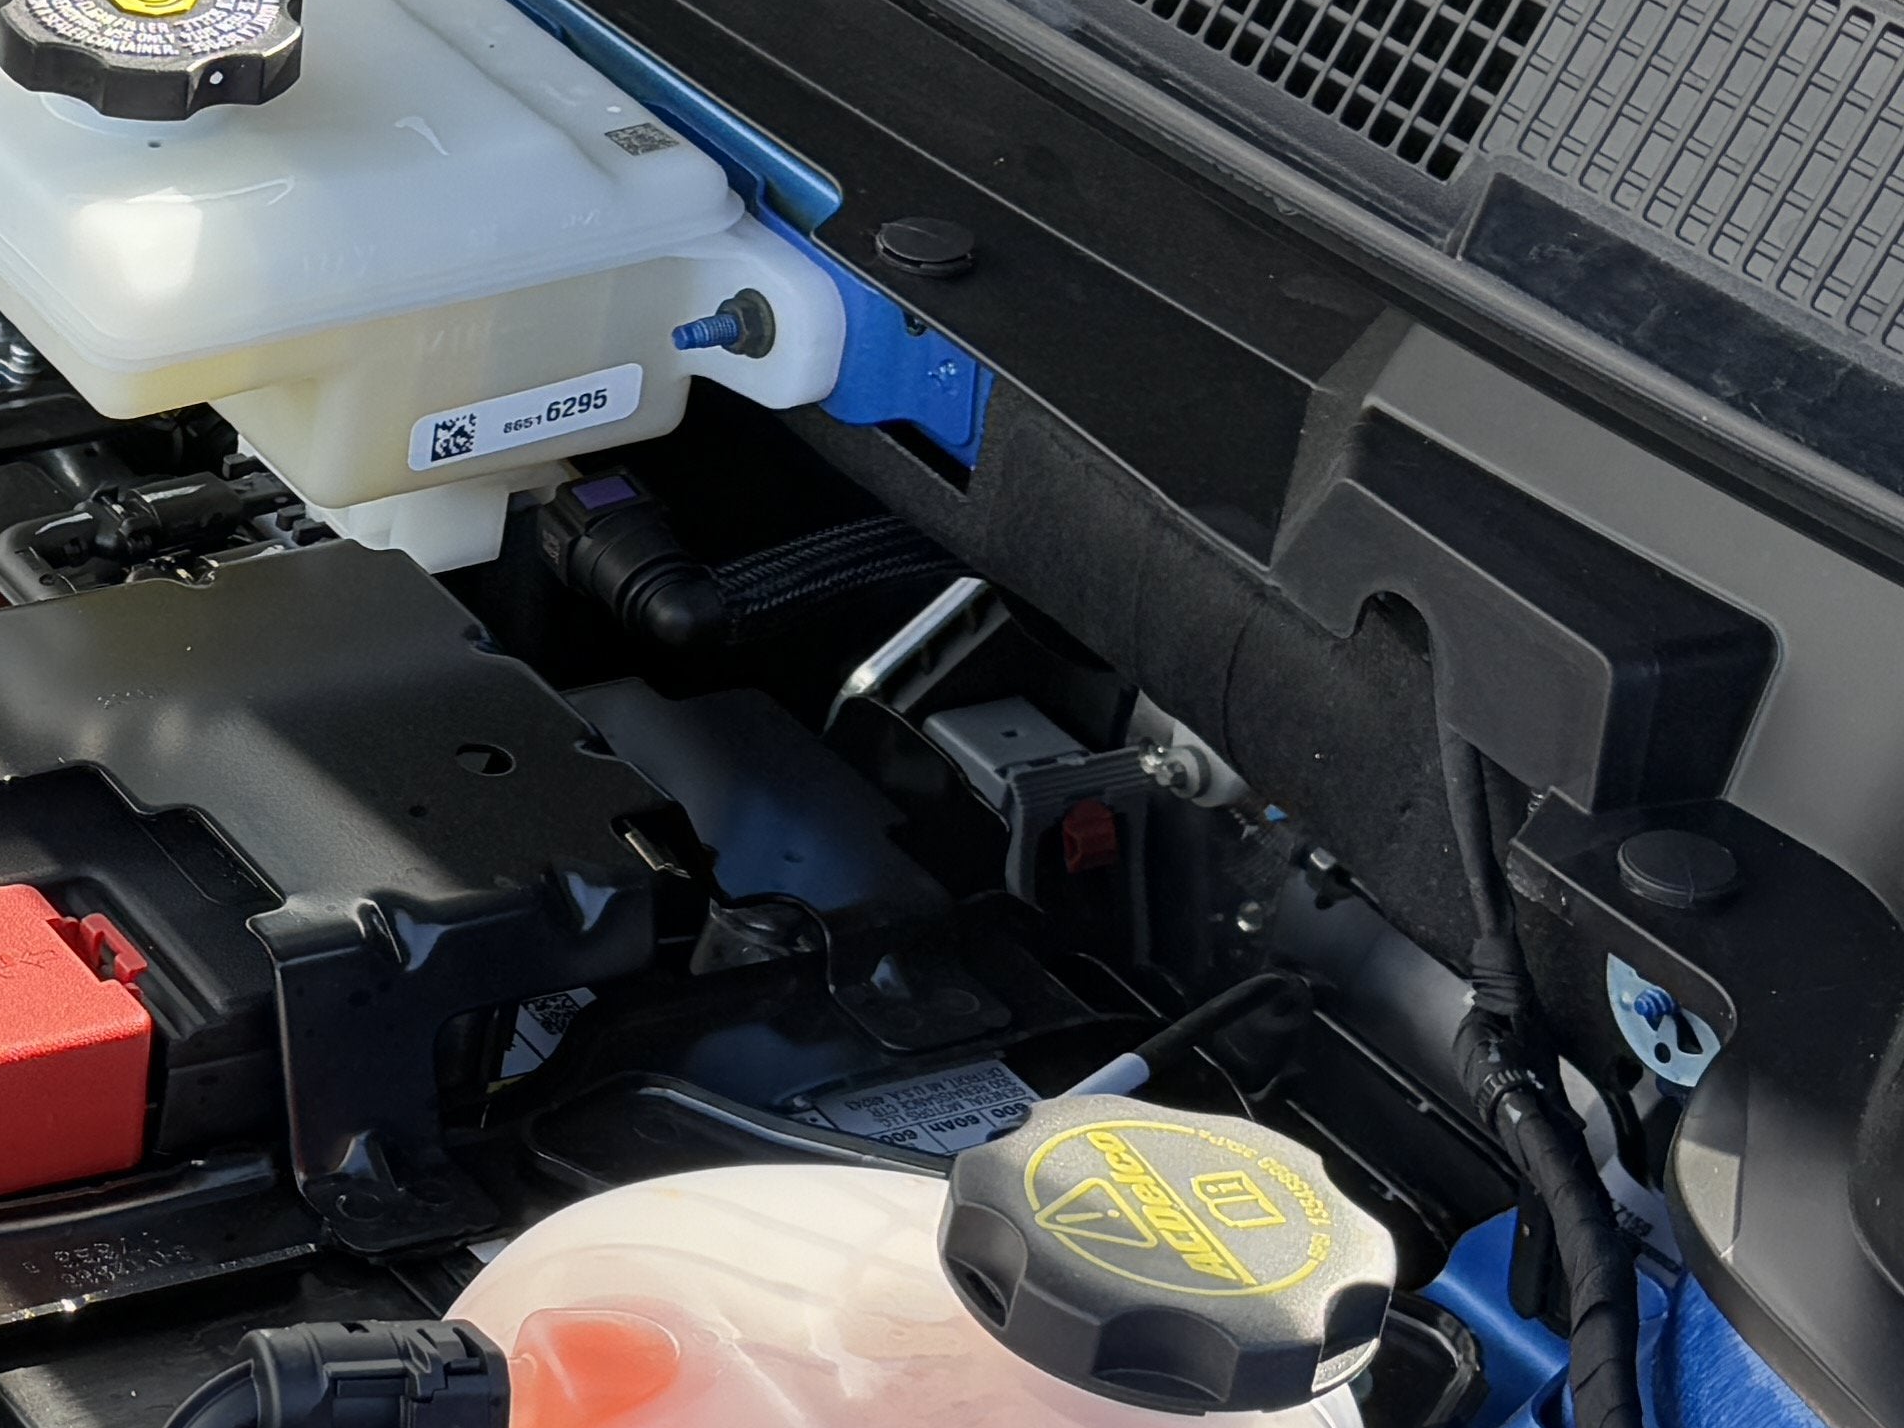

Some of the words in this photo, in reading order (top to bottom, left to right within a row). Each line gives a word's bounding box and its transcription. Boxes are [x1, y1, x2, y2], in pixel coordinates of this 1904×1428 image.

[136, 31, 176, 44] ONLY
[900, 1081, 988, 1111] RENAISSANCE
[968, 1086, 1027, 1109] GENERAL
[910, 1100, 965, 1122] MOTORS
[928, 1114, 981, 1134] 60Ah
[1086, 1130, 1238, 1280] ACDelco
